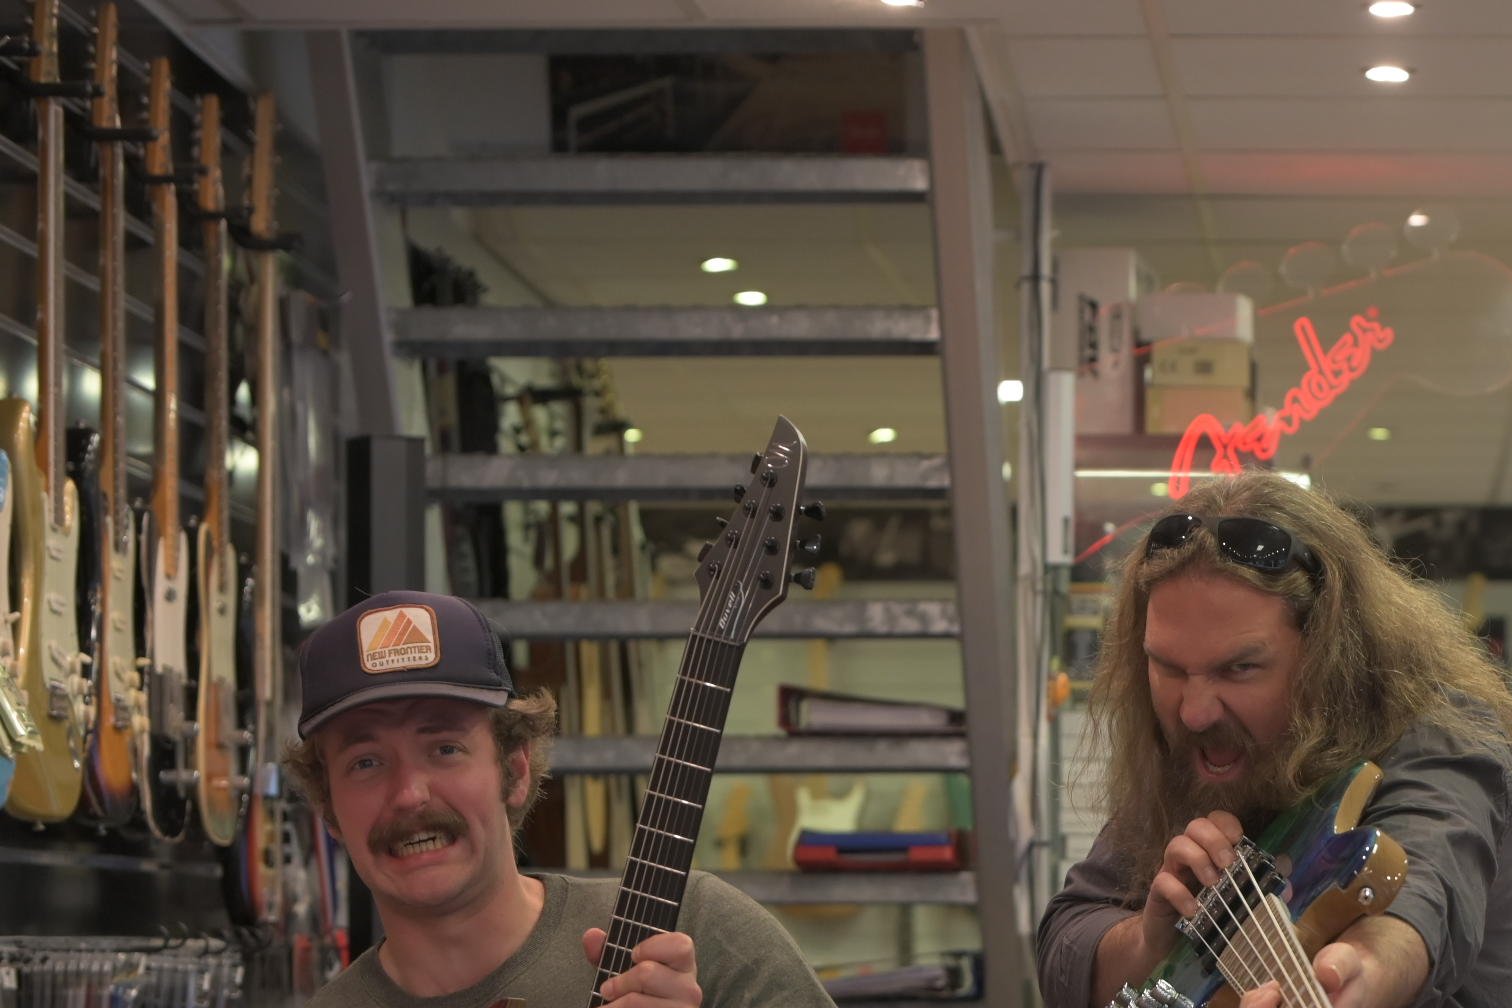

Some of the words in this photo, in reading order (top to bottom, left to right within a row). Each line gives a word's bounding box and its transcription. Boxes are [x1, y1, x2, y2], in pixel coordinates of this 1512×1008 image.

[366, 649, 387, 663] NEW
[387, 645, 432, 658] FRONTIER
[371, 655, 430, 668] OUTFITTERS
